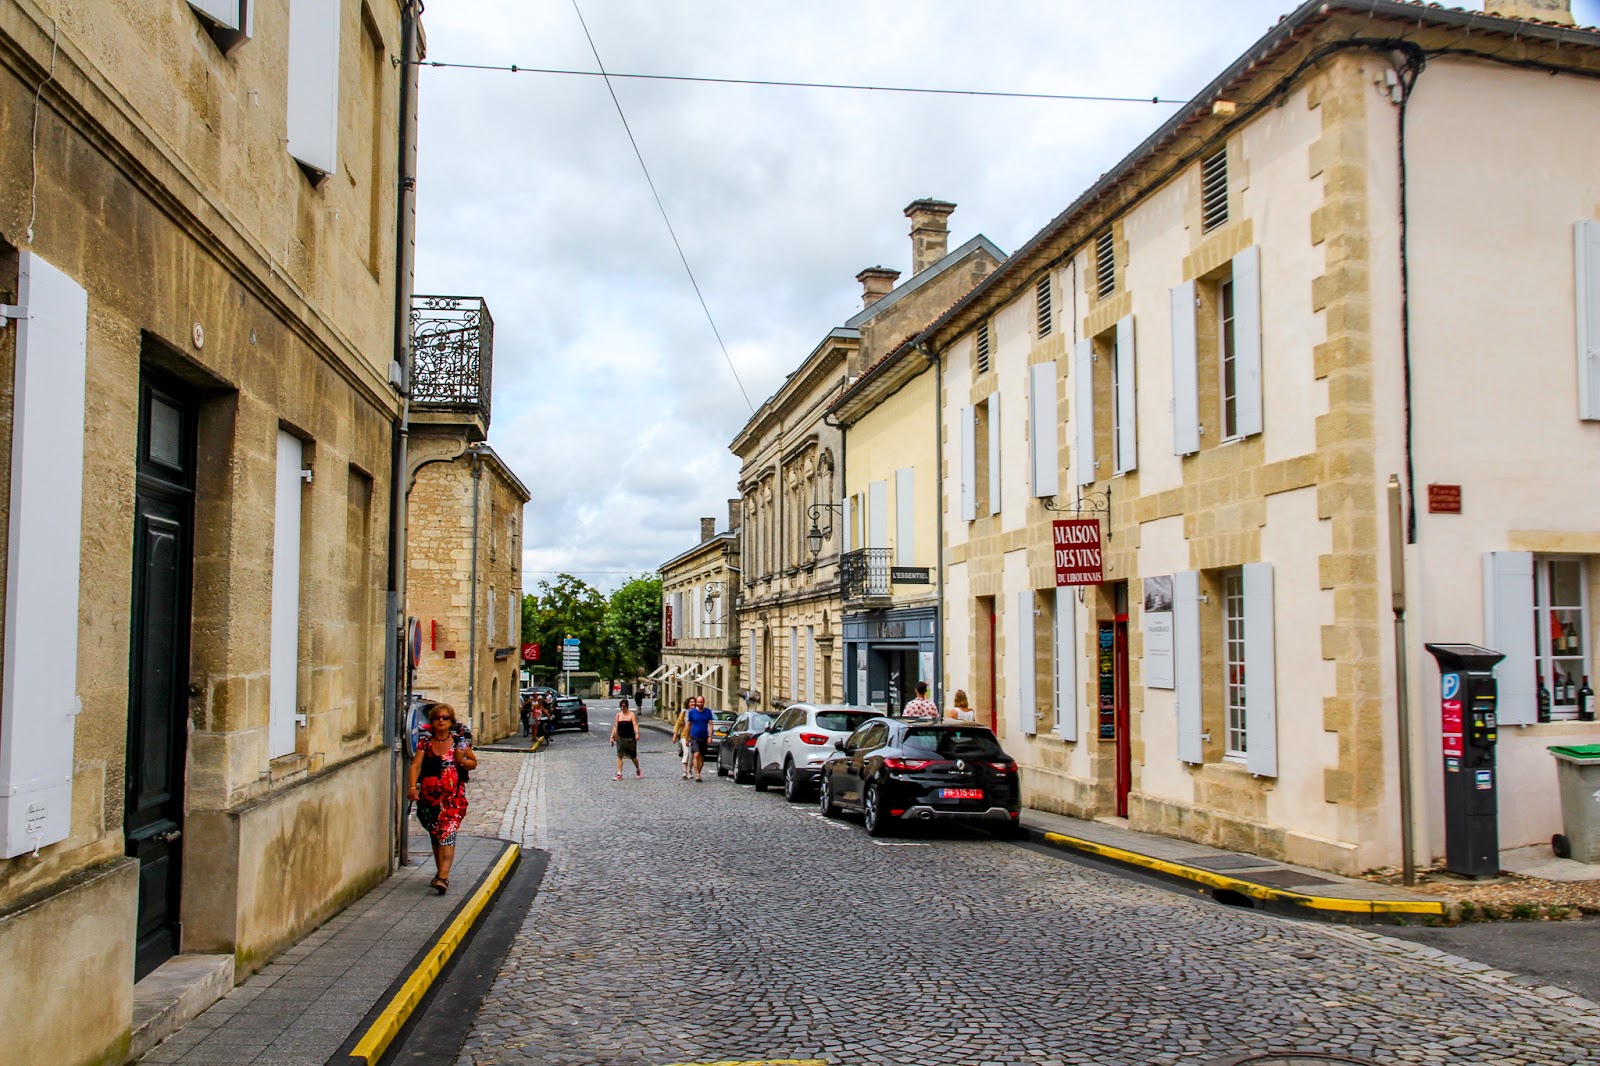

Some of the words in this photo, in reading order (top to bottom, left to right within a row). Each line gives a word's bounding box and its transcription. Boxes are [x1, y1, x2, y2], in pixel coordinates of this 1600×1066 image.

[1054, 525, 1099, 544] MAISON
[1056, 549, 1075, 567] DES
[1075, 548, 1101, 567] VINS
[1057, 573, 1067, 583] DU
[1067, 572, 1102, 582] LIBOURNAIS
